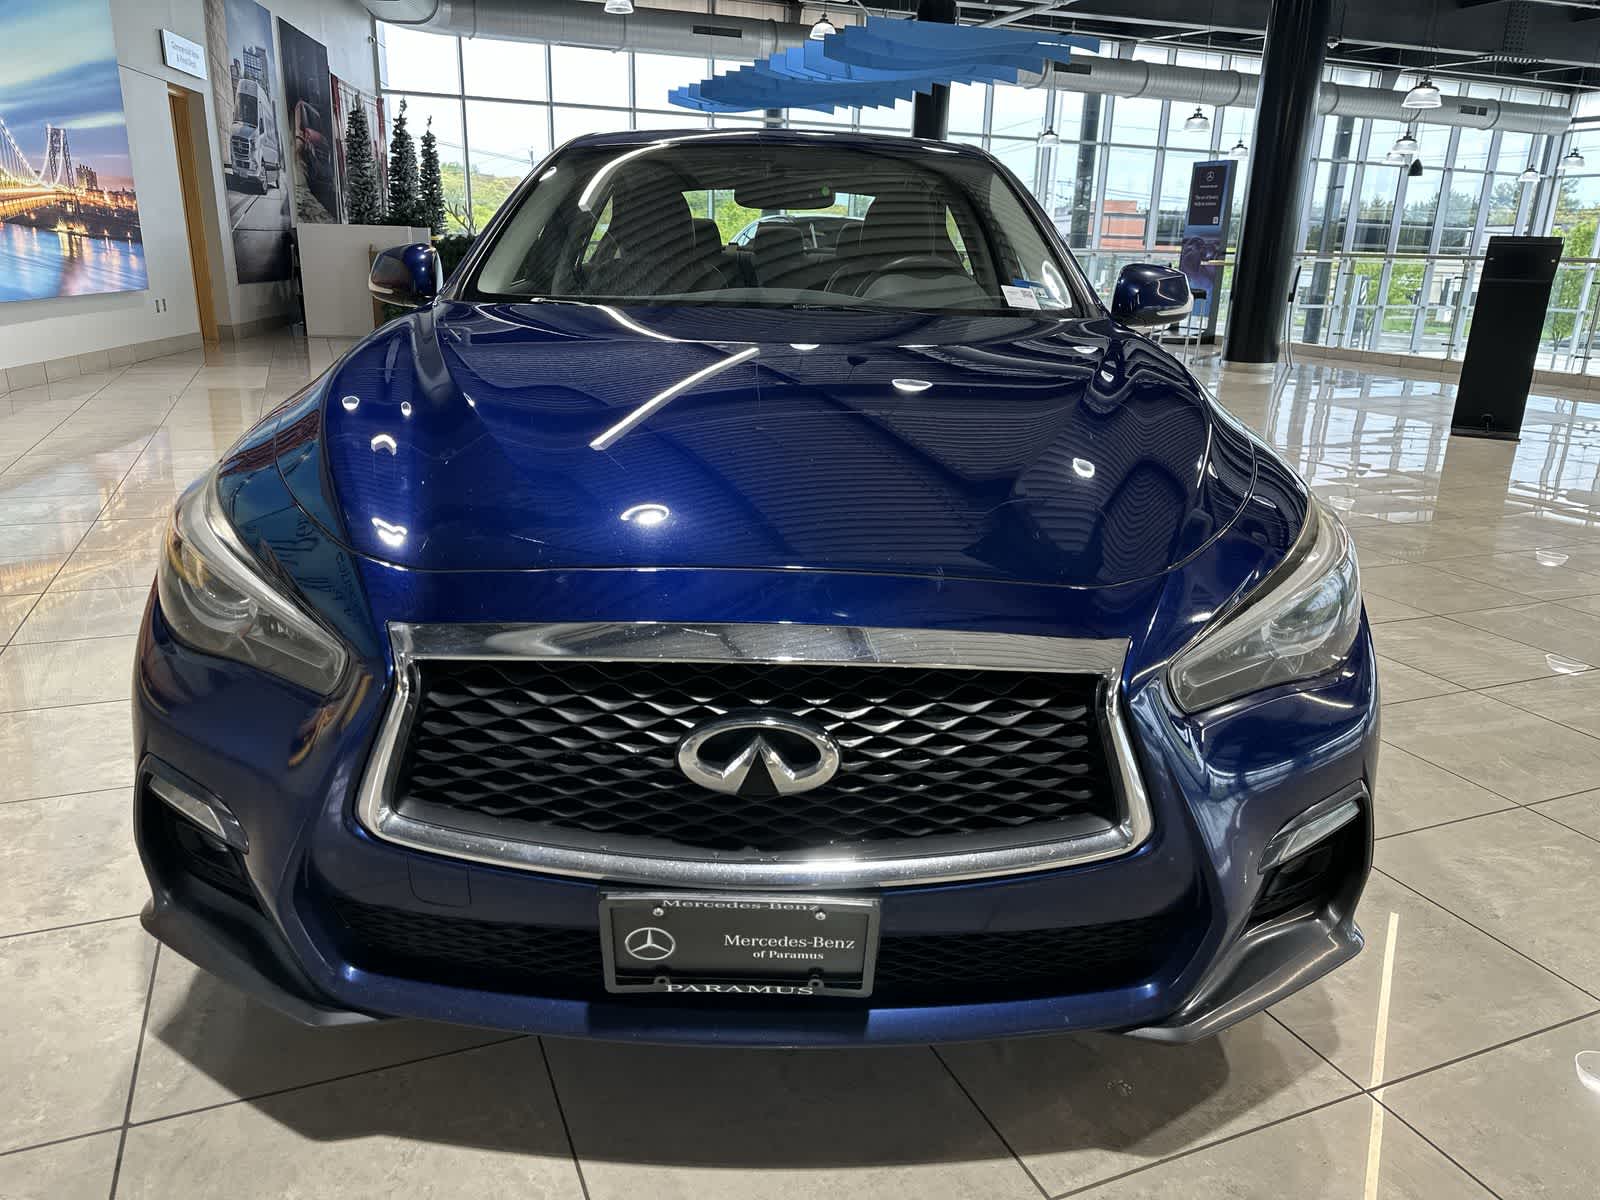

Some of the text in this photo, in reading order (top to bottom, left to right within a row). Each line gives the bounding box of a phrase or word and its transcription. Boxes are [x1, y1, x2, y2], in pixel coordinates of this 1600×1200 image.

[663, 900, 820, 911] Mercedes-Benz
[723, 934, 856, 949] Mercedes-Benz
[752, 950, 824, 960] of Paramus
[666, 984, 814, 995] PARAMUS
